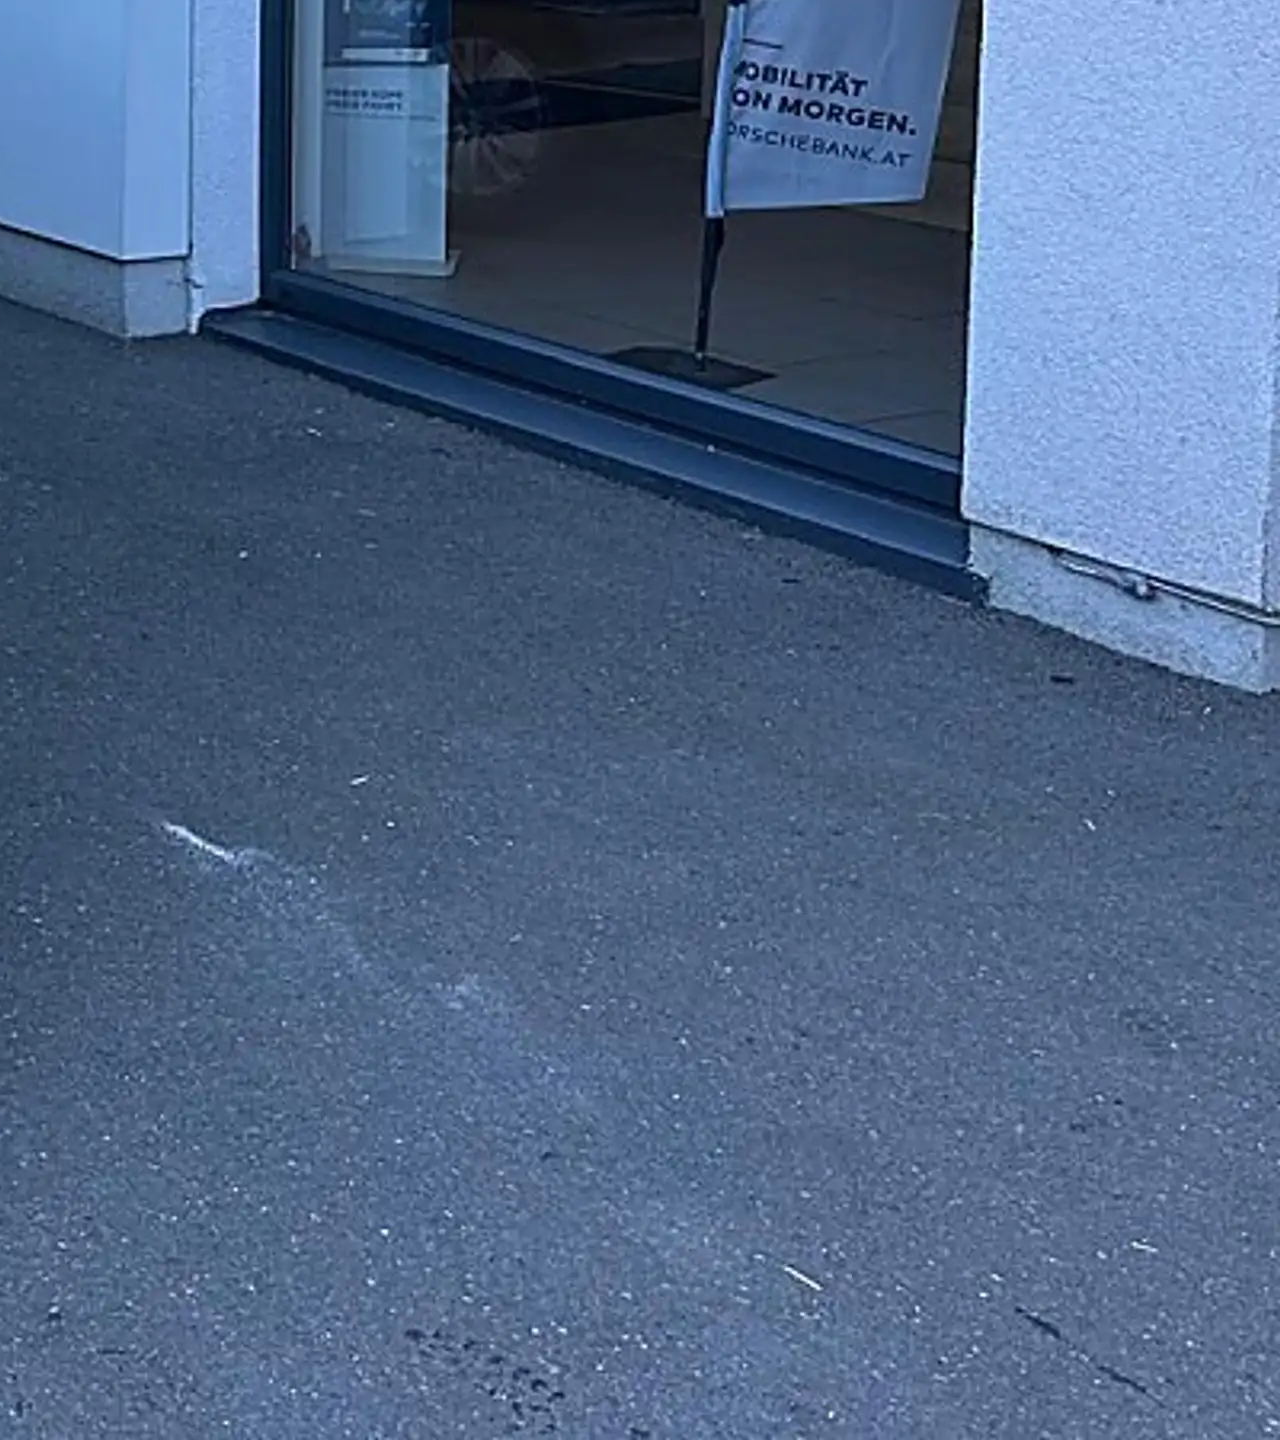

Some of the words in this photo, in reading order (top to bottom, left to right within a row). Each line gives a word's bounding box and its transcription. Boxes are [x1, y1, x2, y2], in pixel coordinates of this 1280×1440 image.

[730, 88, 773, 110] ON
[778, 95, 917, 137] MORGEN.
[726, 121, 914, 168] ORSCHEBANK.AT
